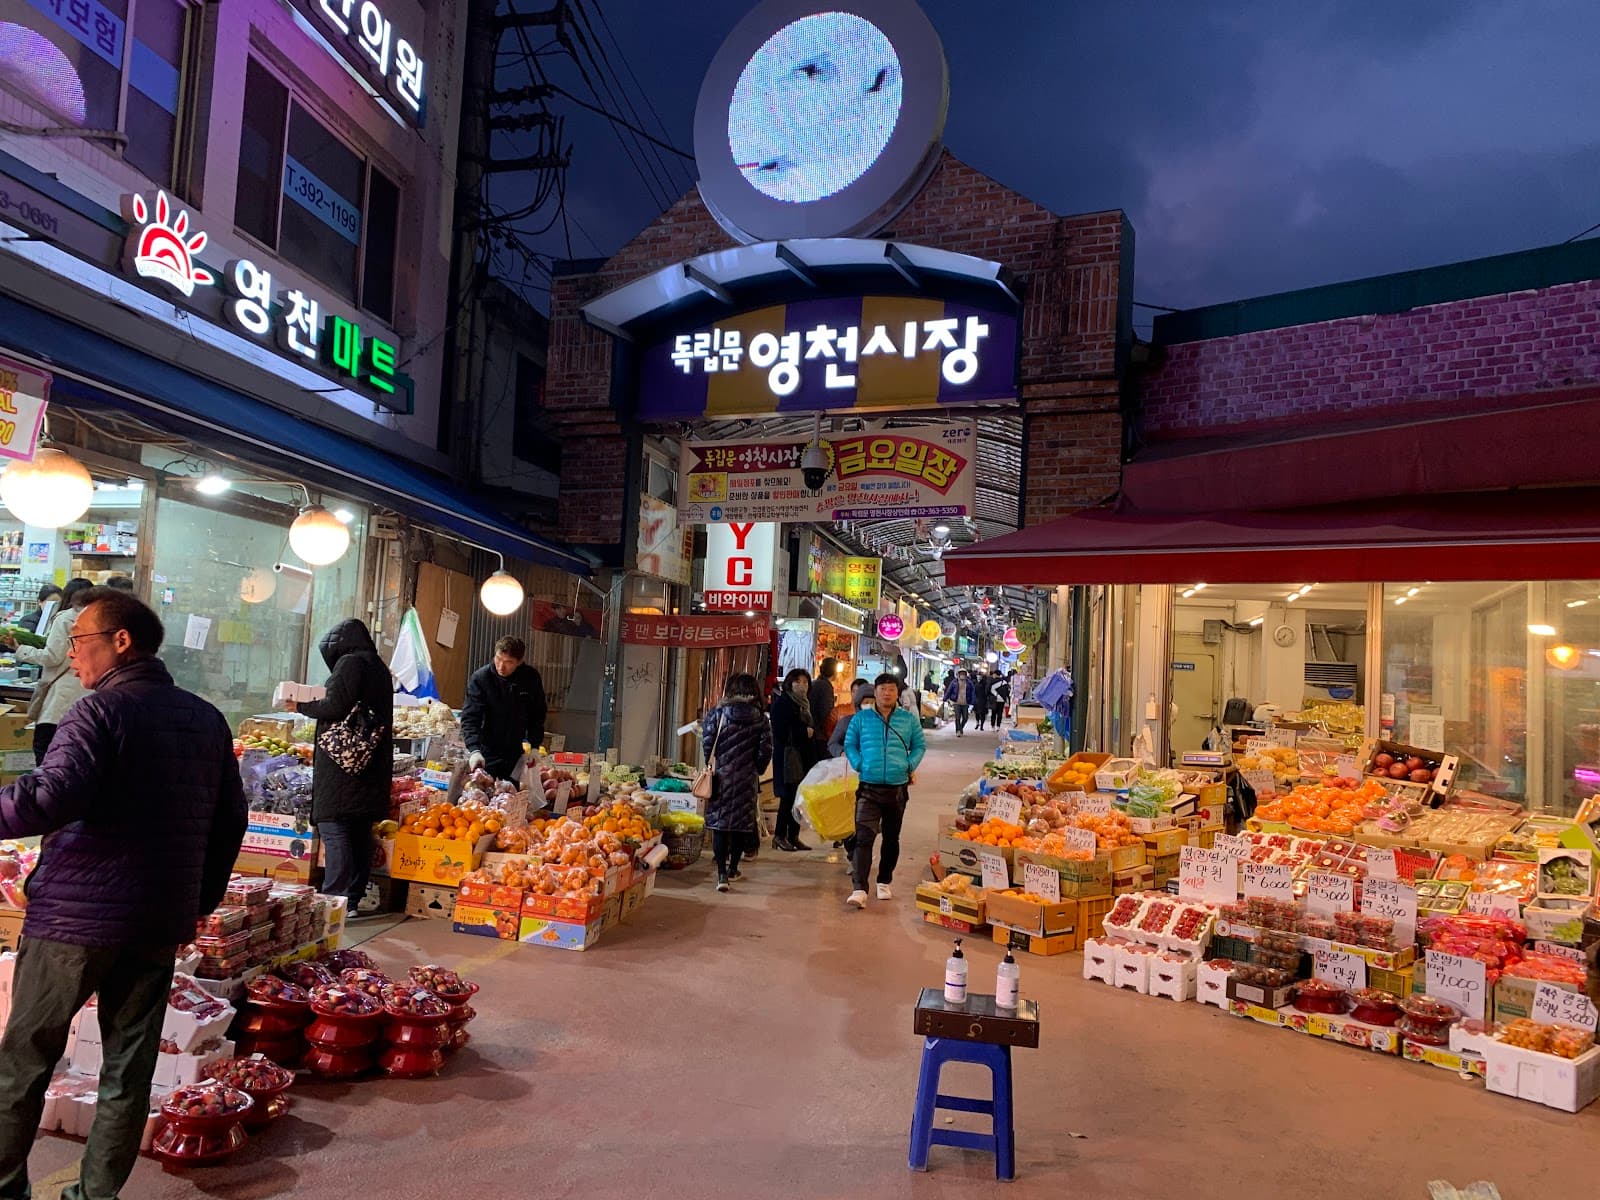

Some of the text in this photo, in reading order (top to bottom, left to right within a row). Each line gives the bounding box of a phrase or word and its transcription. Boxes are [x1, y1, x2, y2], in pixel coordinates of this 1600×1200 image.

[286, 163, 358, 234] T.392-1199
[670, 316, 989, 396] 독립문 영천시장
[704, 446, 801, 470] 독립문 영천시장
[838, 439, 958, 487] 금요일장
[708, 593, 768, 608] 비와이씨
